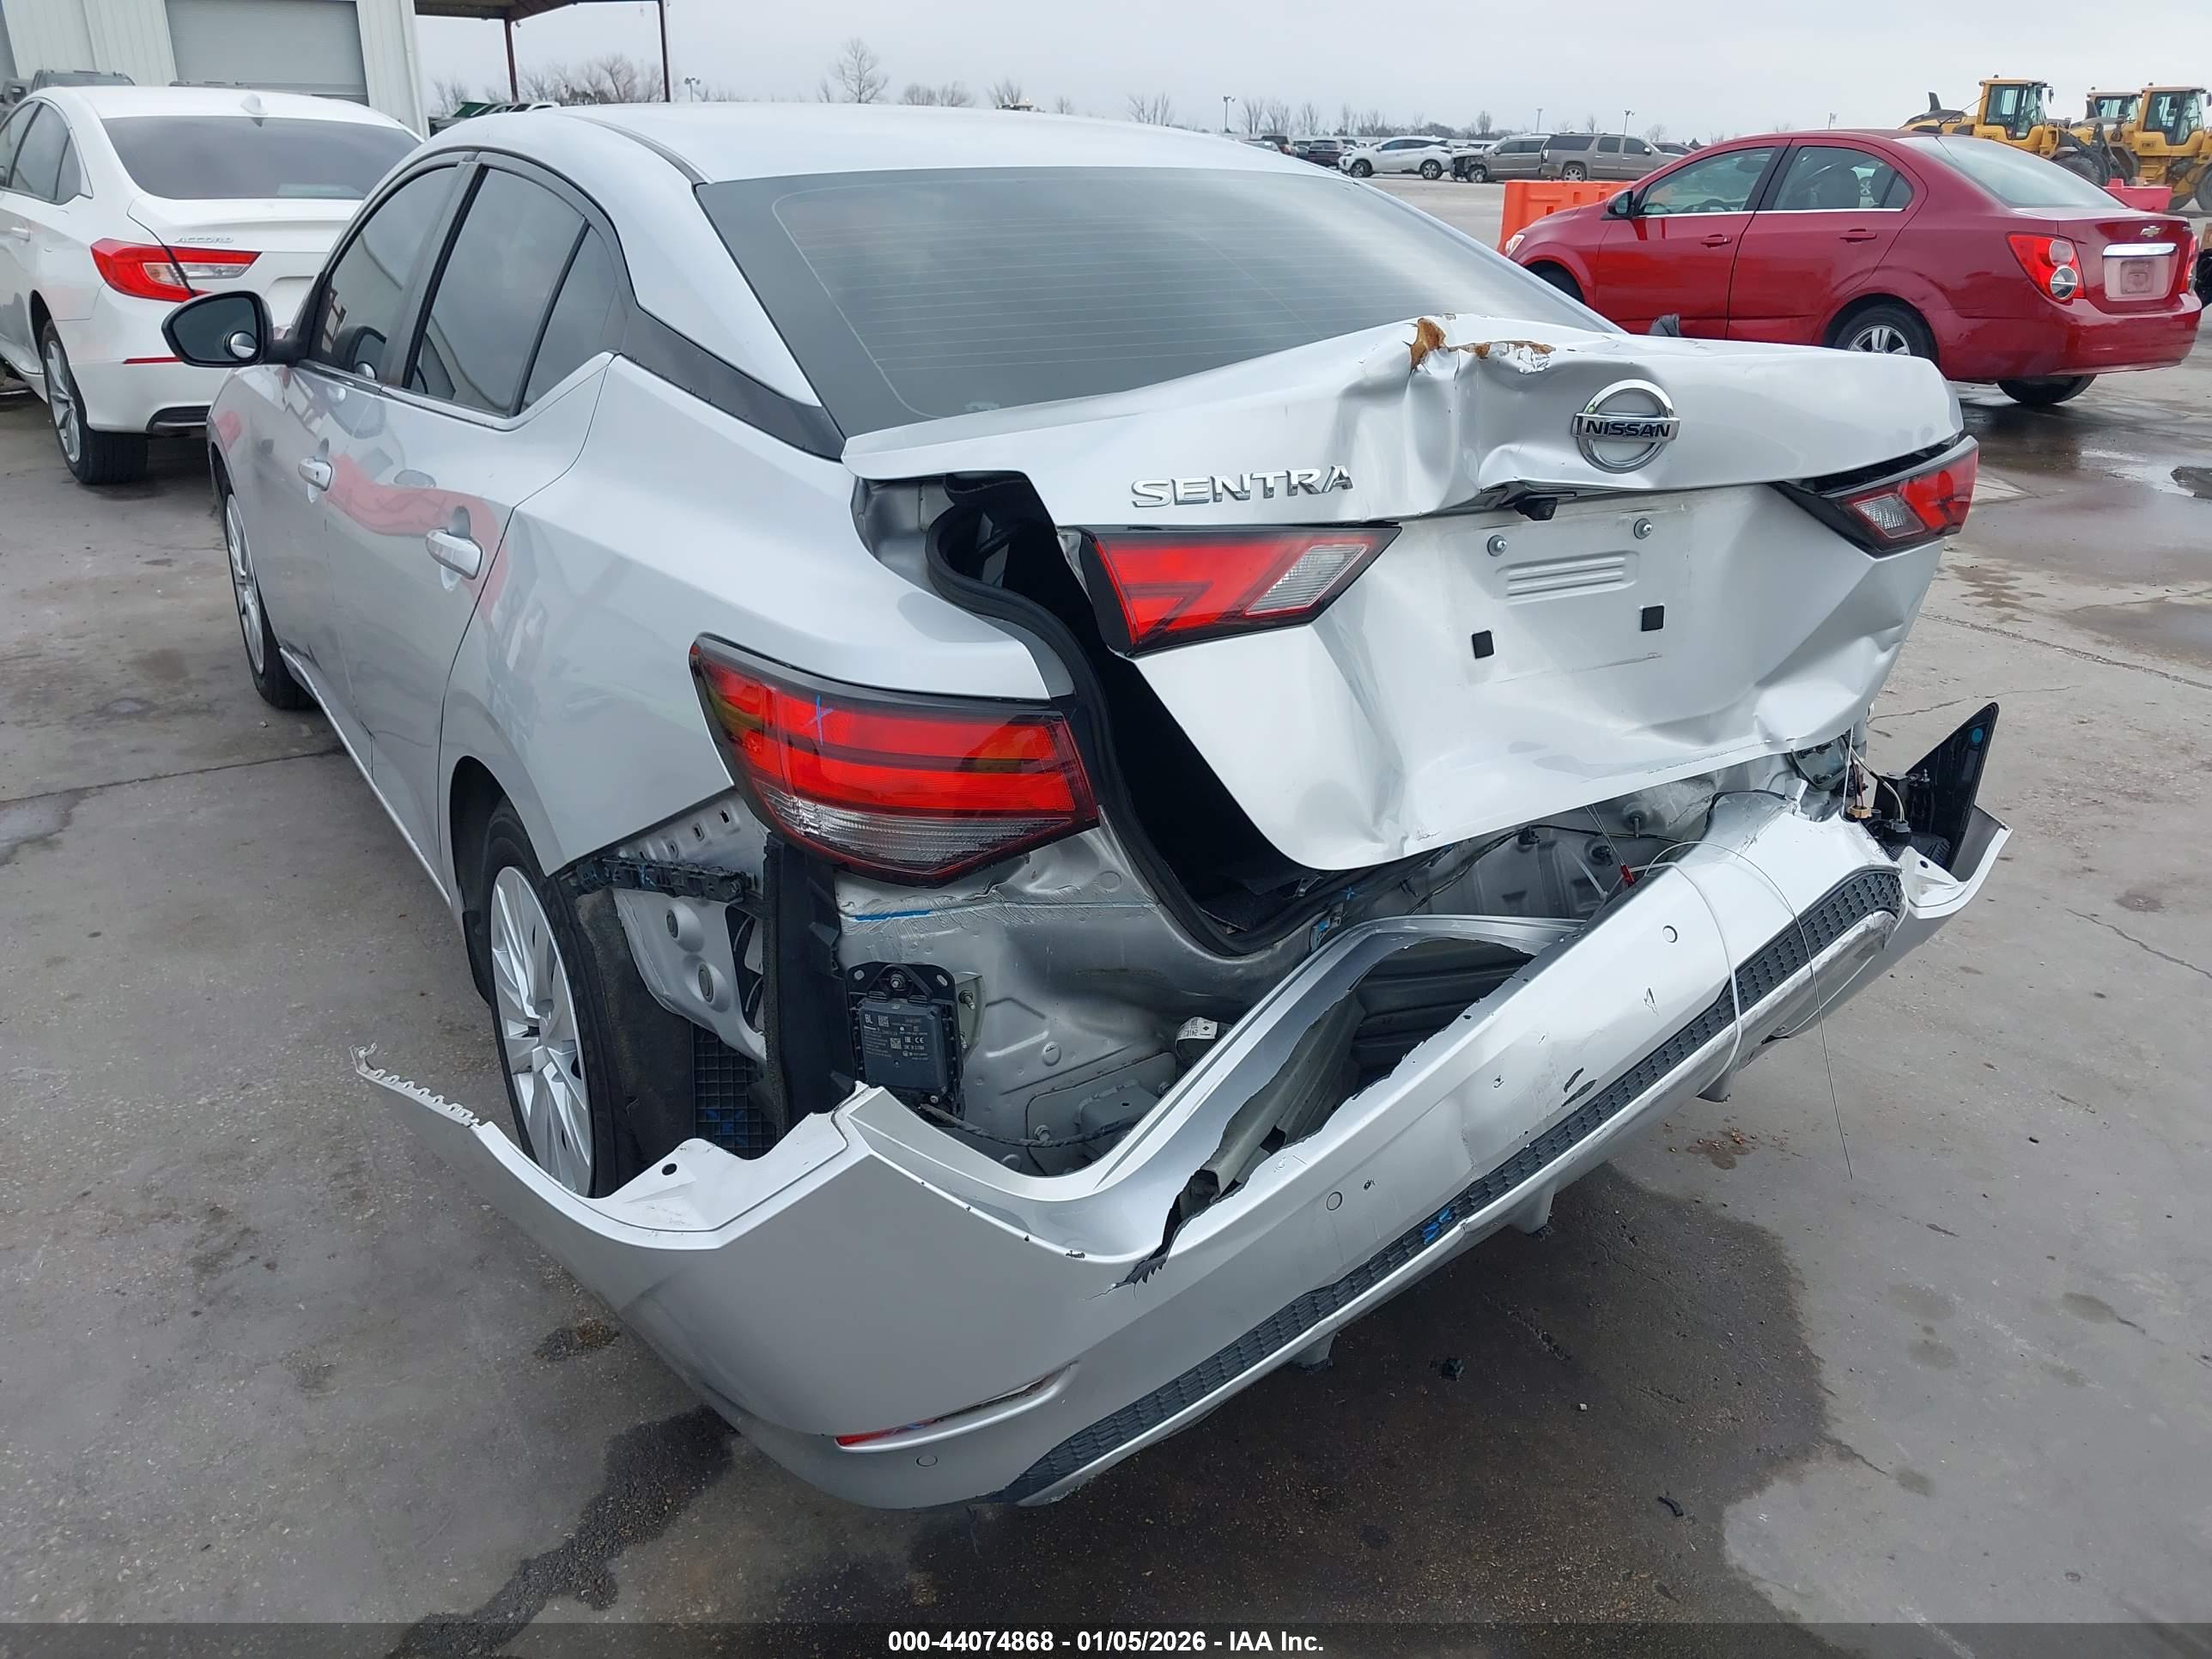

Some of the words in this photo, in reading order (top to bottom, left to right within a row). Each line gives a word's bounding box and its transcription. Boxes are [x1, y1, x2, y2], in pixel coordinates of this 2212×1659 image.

[174, 235, 234, 244] ACCORD
[1585, 420, 1671, 438] NISSAN
[1131, 465, 1354, 507] SENTRA
